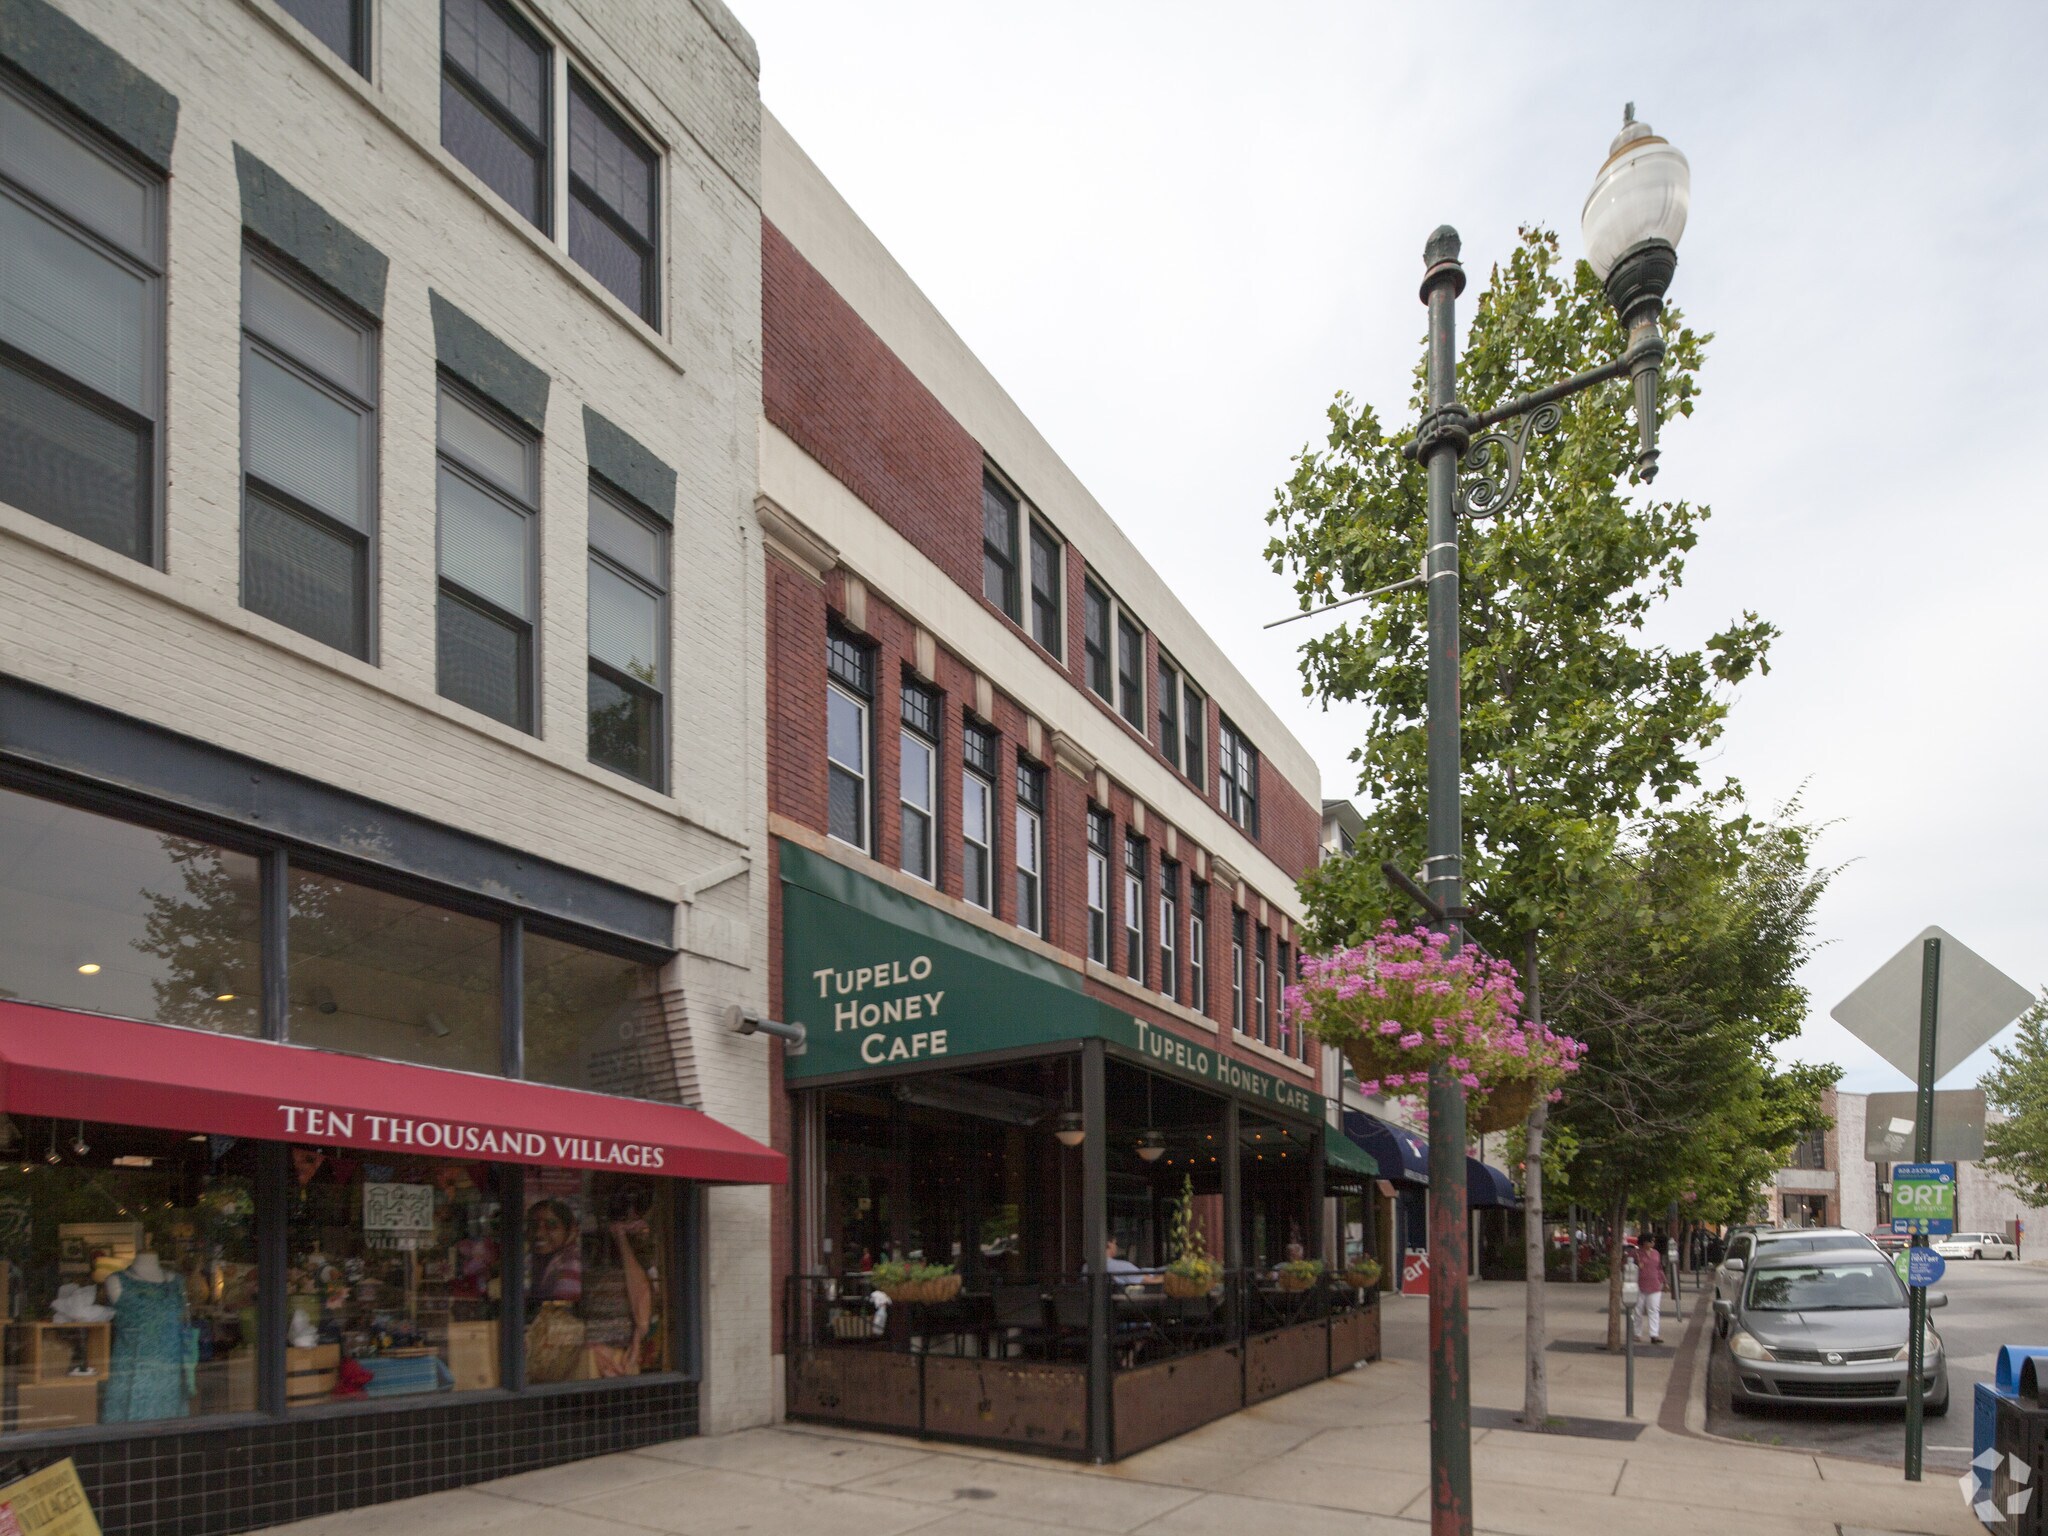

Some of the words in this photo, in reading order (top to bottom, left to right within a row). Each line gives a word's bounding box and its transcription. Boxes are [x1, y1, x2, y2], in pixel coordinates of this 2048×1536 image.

[813, 955, 932, 998] TUPELO
[834, 990, 945, 1032] HONEY
[861, 1029, 947, 1064] CAFE
[1134, 1017, 1209, 1075] TUPELO
[1217, 1053, 1269, 1098] HONEY
[1275, 1078, 1310, 1113] CAFE
[277, 1105, 355, 1138] TEN
[364, 1115, 547, 1157] THOUSAND
[552, 1136, 665, 1168] VILLAGES
